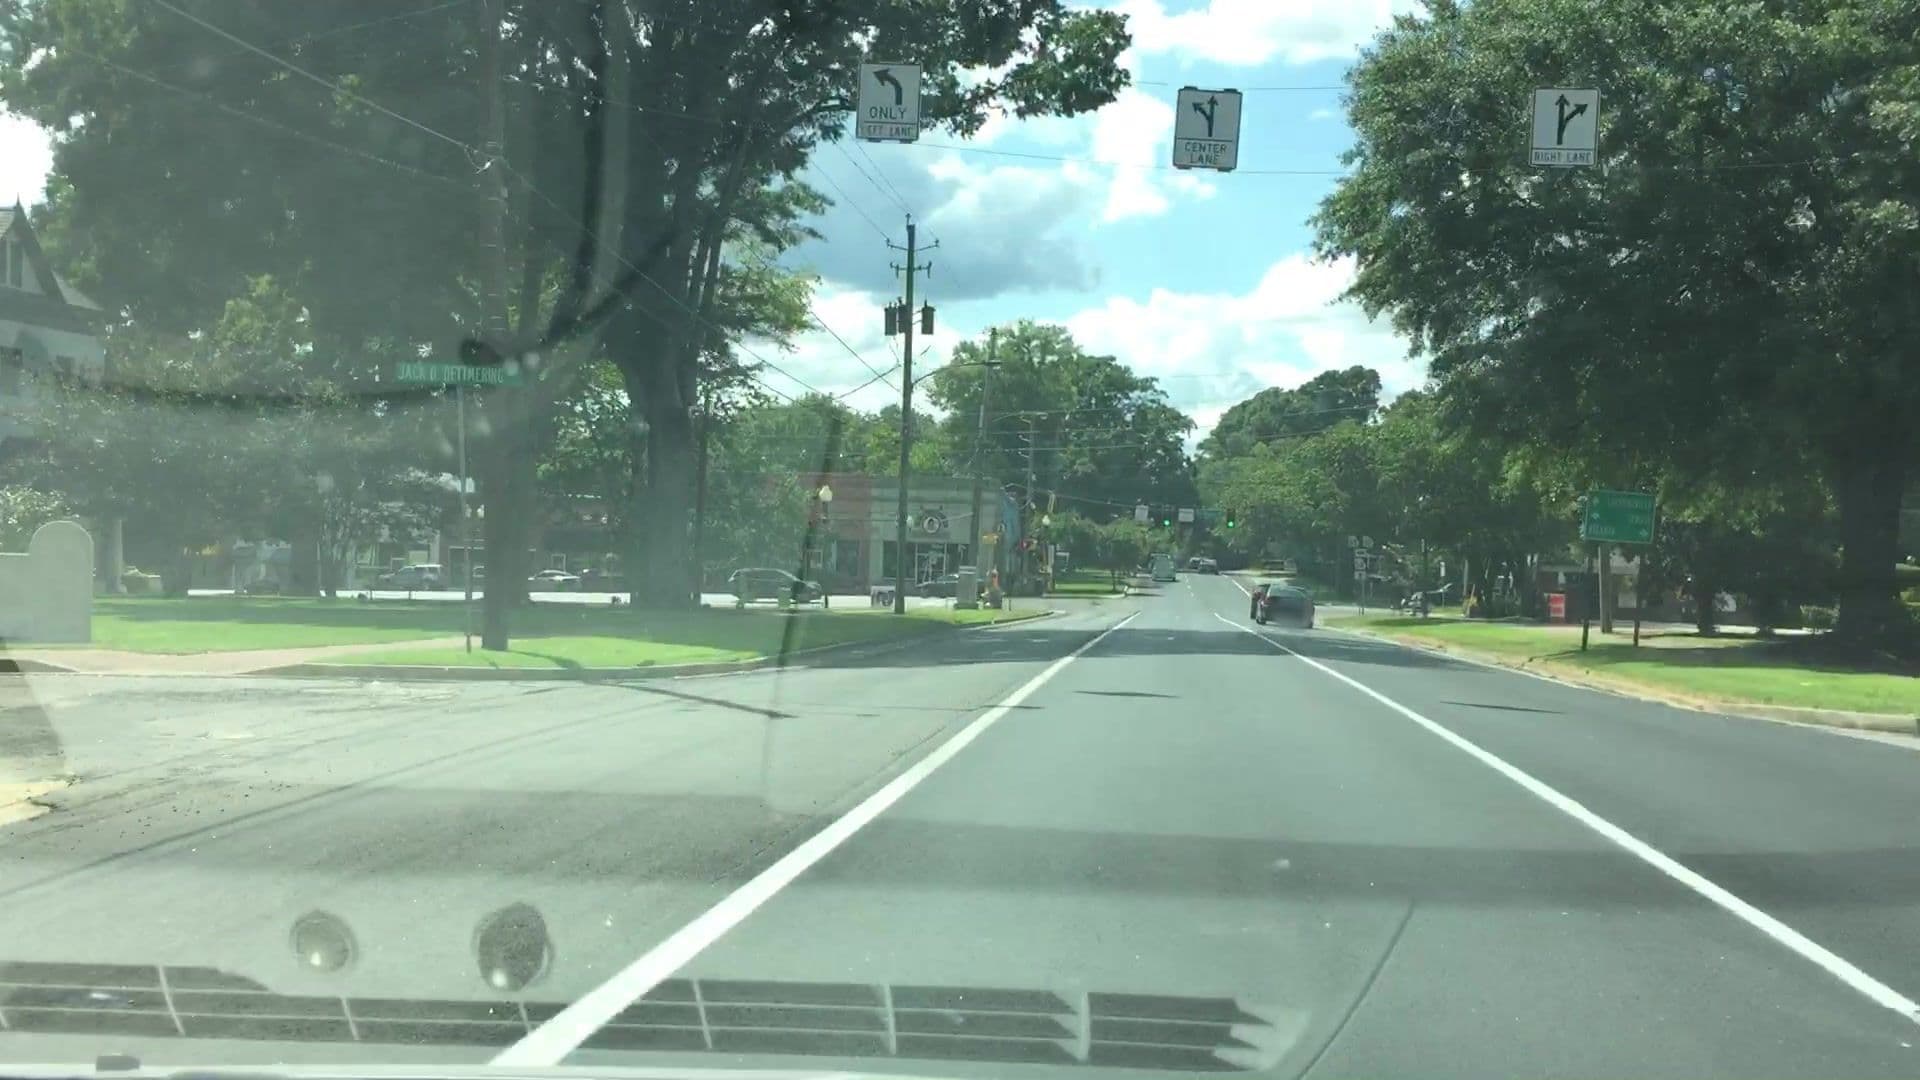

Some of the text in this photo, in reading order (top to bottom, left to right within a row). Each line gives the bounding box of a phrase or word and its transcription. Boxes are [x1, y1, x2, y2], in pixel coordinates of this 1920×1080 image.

[869, 106, 907, 120] ONLY
[889, 126, 913, 137] LANE
[1184, 142, 1227, 153] CENTER
[1189, 154, 1220, 165] LANE
[1534, 151, 1592, 163] RIGHT LANE
[398, 363, 425, 380] JACK
